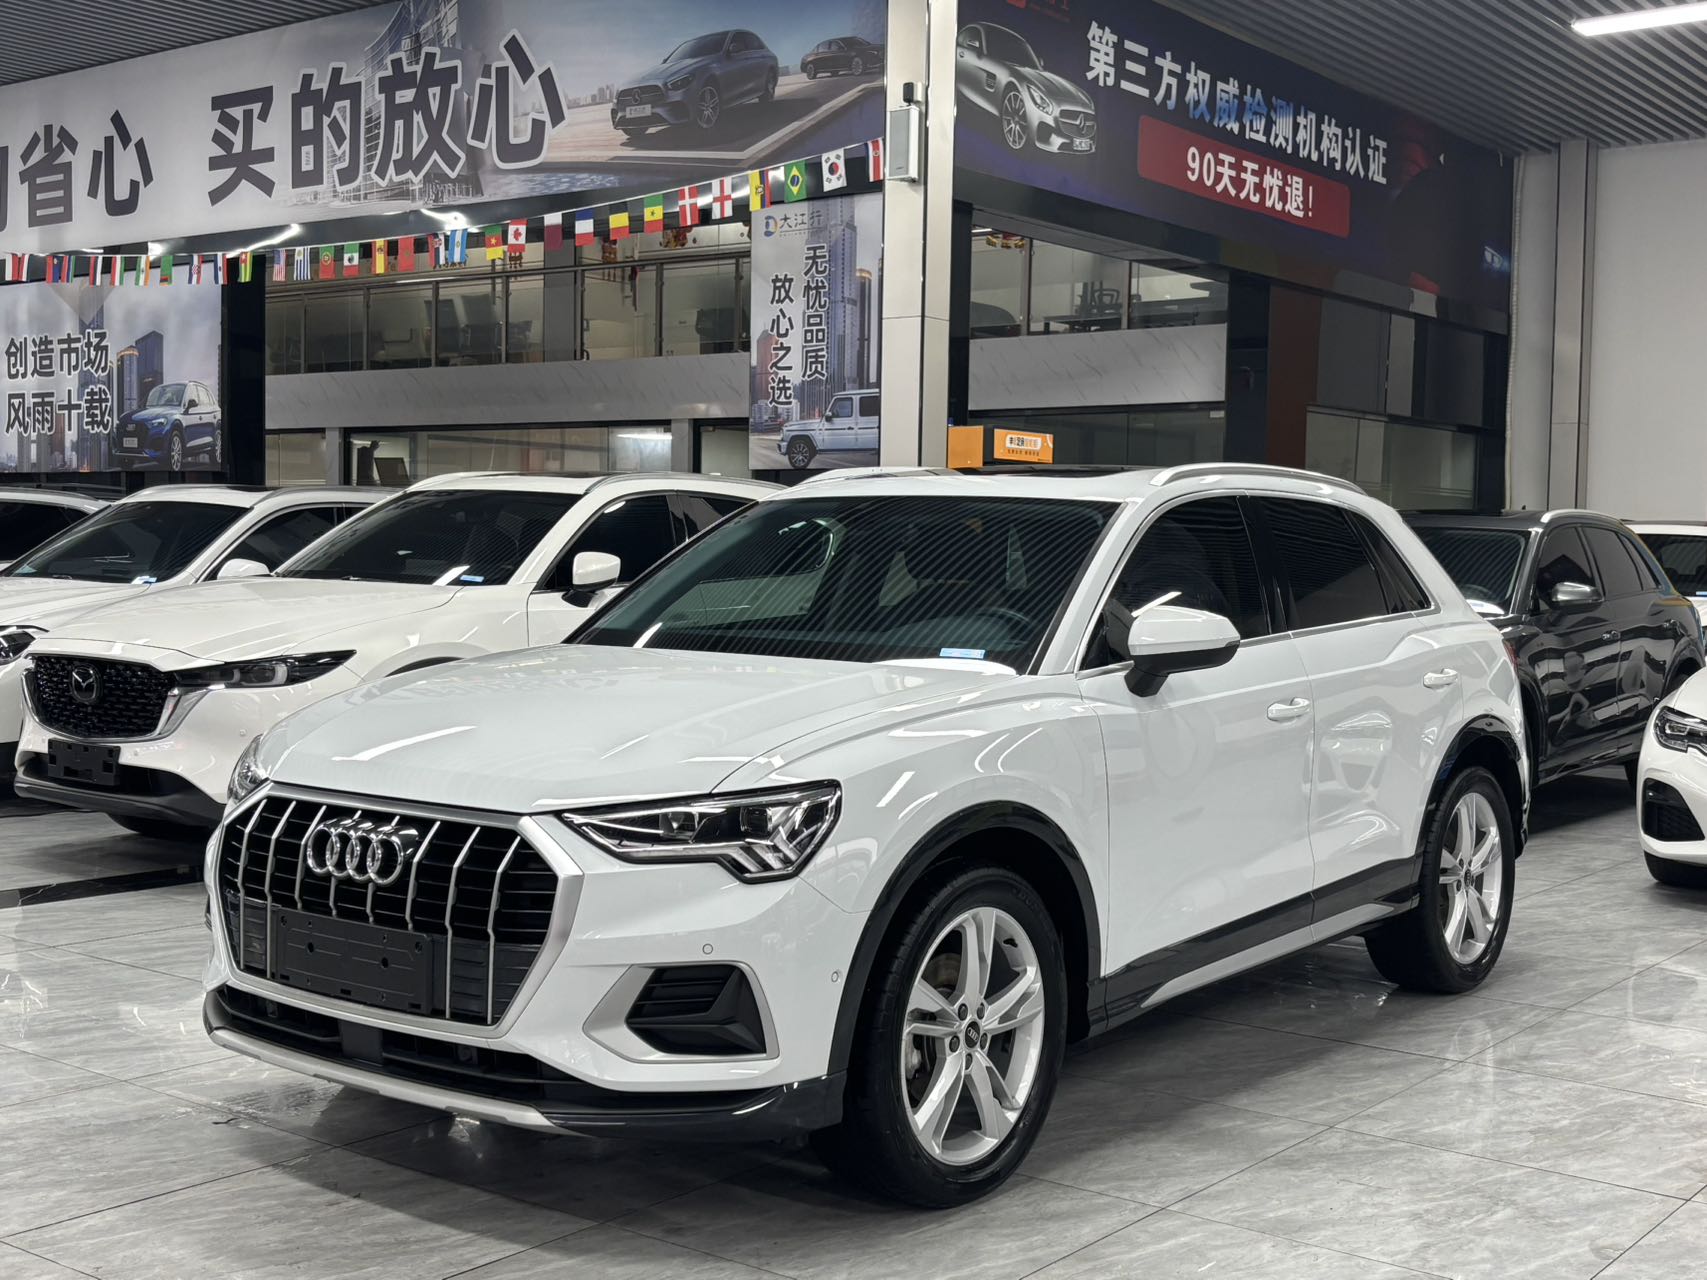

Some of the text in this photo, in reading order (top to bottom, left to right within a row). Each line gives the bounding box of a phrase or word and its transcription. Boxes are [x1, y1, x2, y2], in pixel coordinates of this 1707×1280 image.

[207, 33, 566, 207] 买的放心
[1085, 20, 1388, 185] 第三方权威检测机构认证
[4, 331, 110, 380] 创造市场
[768, 273, 795, 406] 放心之选
[801, 244, 828, 380] 无忧品质
[5, 386, 111, 434] 风雨十载
